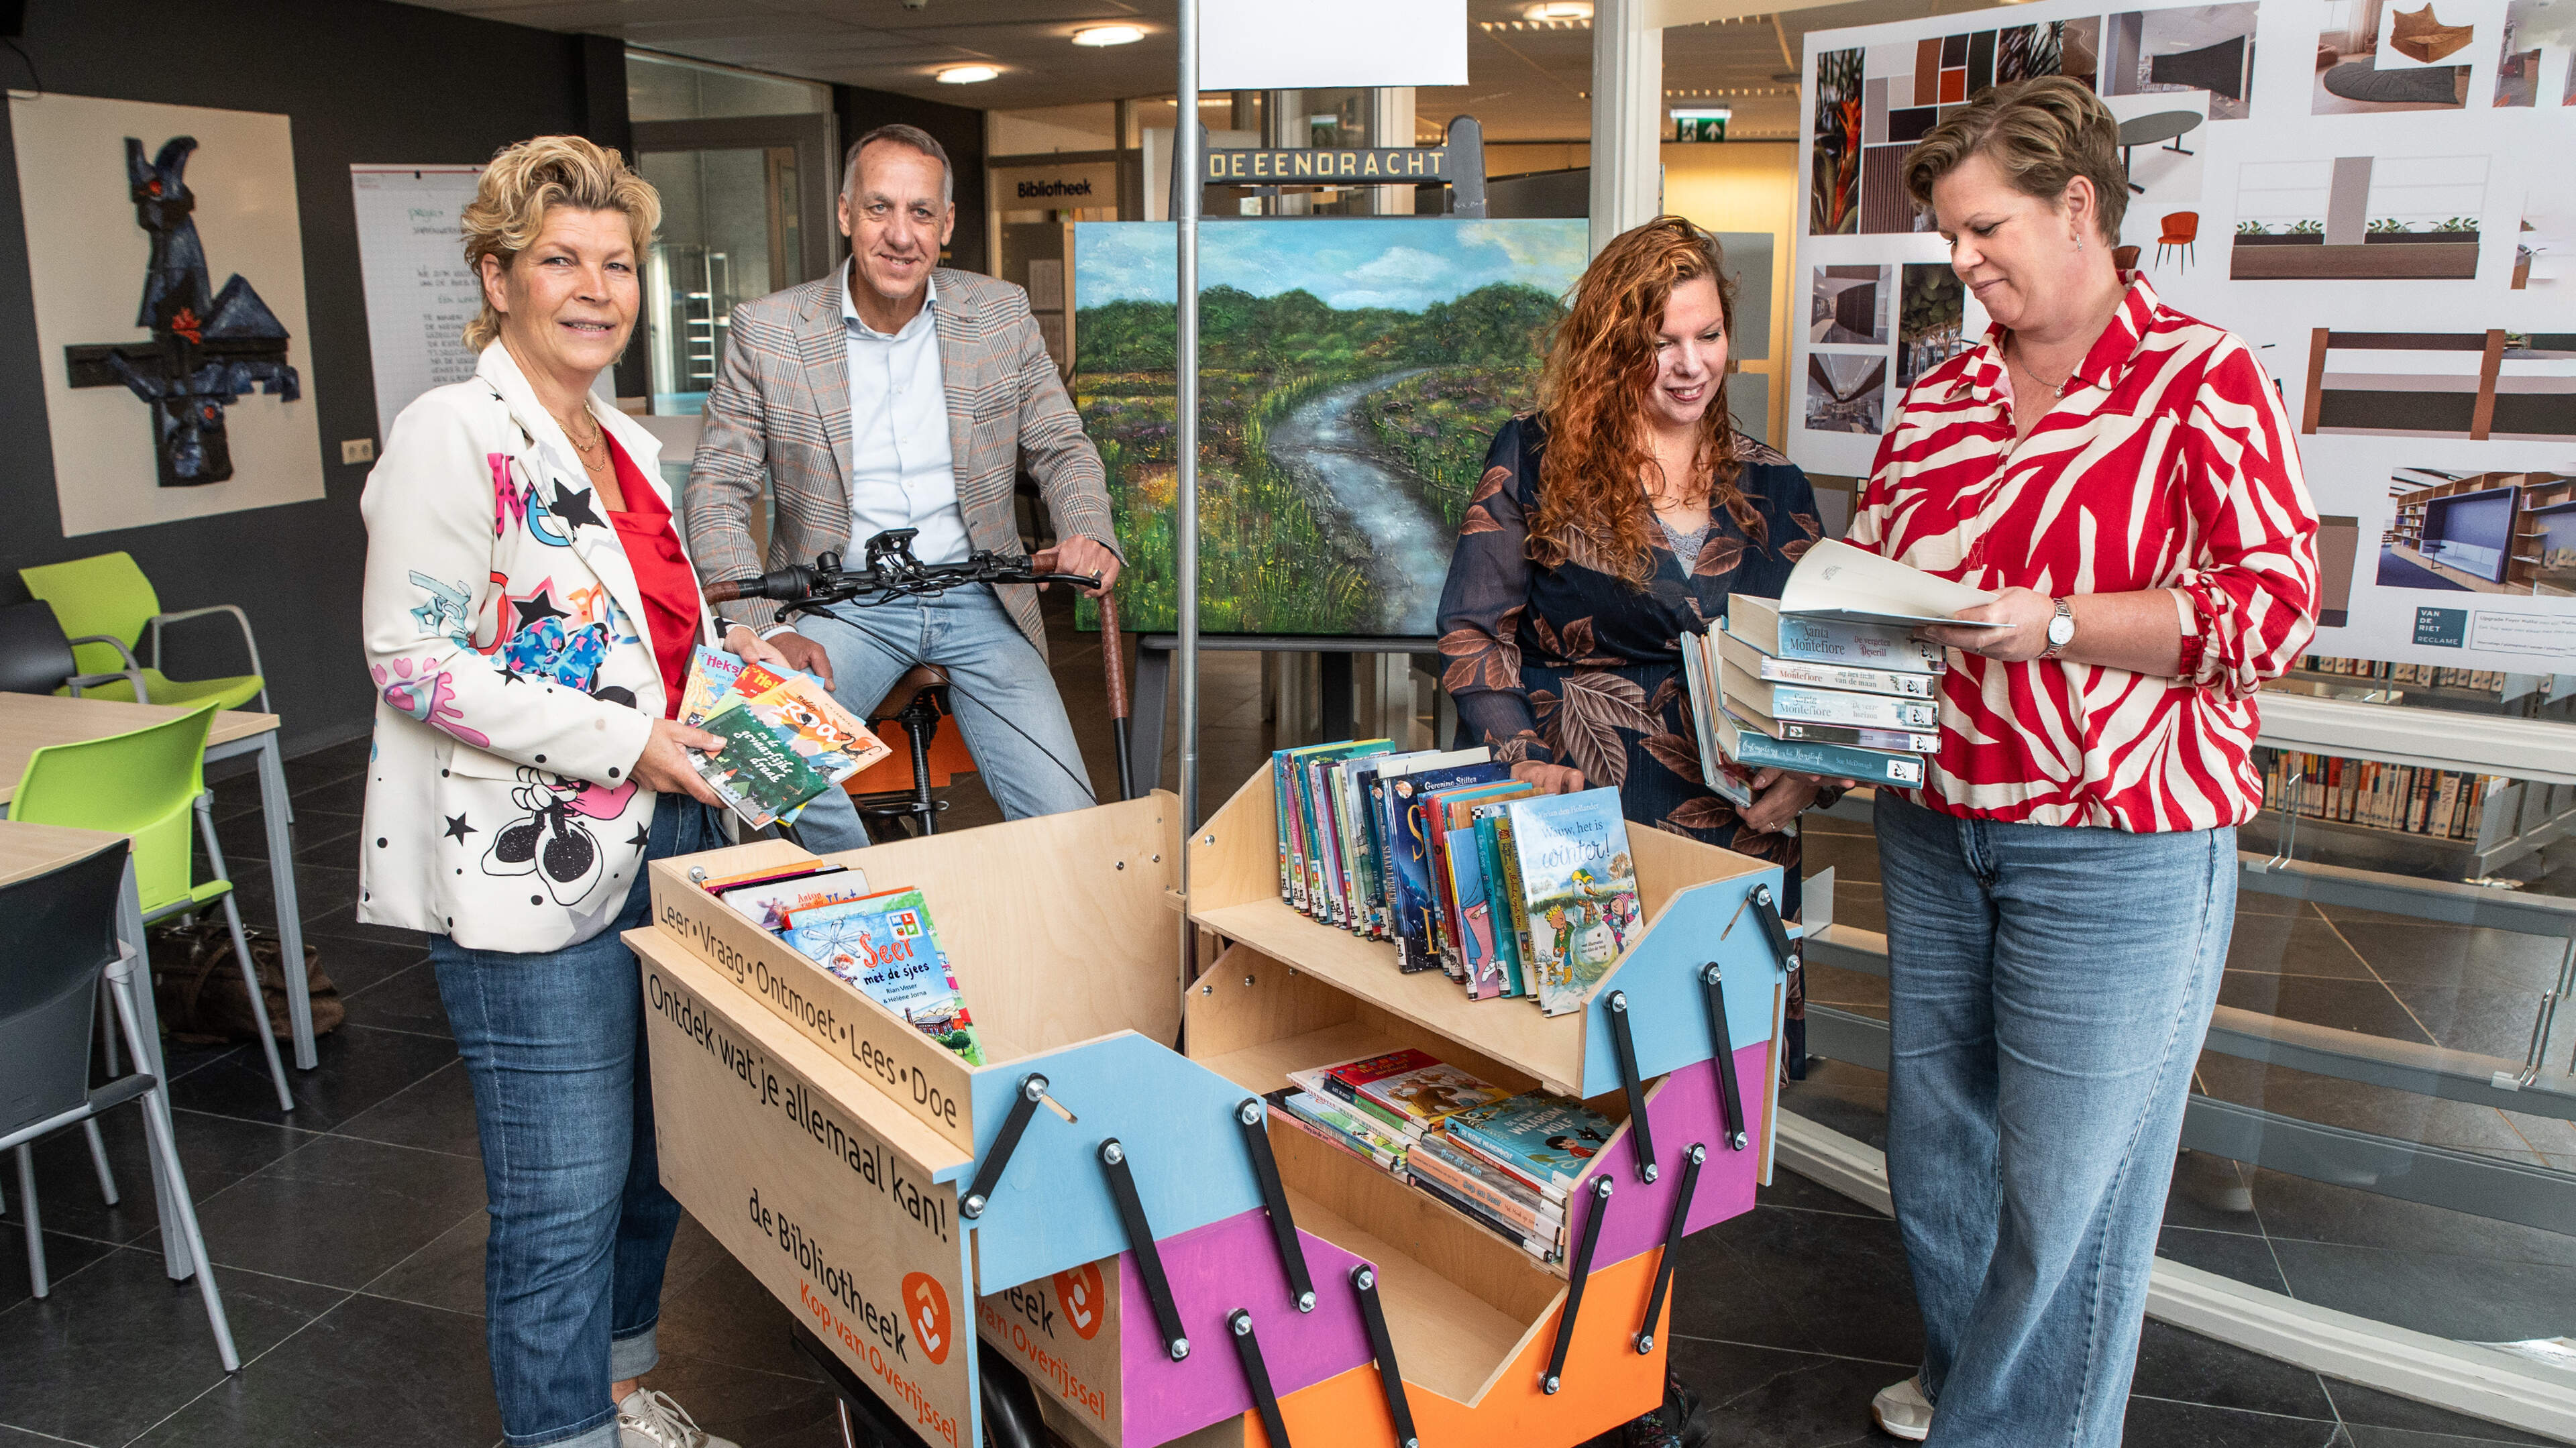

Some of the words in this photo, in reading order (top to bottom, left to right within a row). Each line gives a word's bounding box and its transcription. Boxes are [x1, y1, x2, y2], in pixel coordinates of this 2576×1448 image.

[1018, 178, 1092, 198] Bibliotheek
[2420, 609, 2441, 617] VAN
[1803, 624, 1829, 641] Santa
[2418, 624, 2442, 632] RIET
[1790, 638, 1845, 655] Montefiore
[1854, 635, 1863, 644] De
[1864, 637, 1891, 647] vergeten
[2417, 635, 2459, 645] RECLAME
[1860, 645, 1887, 658] Deverill
[706, 655, 745, 677] Heksj
[1779, 670, 1823, 682] Montefiore
[1848, 677, 1857, 685] de
[1858, 680, 1877, 688] maan
[1780, 703, 1831, 717] Montefiore
[1853, 710, 1878, 720] horizon
[757, 732, 769, 740] en
[733, 730, 794, 774] gevaarlijke
[749, 758, 786, 783] draak
[1424, 780, 1455, 791] Geronimo
[1456, 775, 1477, 787] Stilton
[1576, 821, 1593, 834] het
[1594, 819, 1603, 831] is
[1542, 832, 1611, 869] winter!
[798, 892, 822, 903] Anton
[864, 972, 885, 985] met
[888, 968, 900, 980] de
[903, 963, 930, 981] sjees
[885, 987, 900, 995] Rian
[900, 983, 918, 991] Visser
[910, 990, 927, 999] Jorna
[658, 893, 691, 940] Leer
[700, 920, 746, 985] Vraag
[755, 960, 838, 1044] Ontmoet
[851, 1023, 896, 1085] Lees
[912, 1066, 957, 1129] Doe
[649, 973, 716, 1056] Ontdek
[718, 1033, 757, 1090] wat
[759, 1057, 780, 1106] je
[786, 1083, 886, 1194] allemaal
[890, 1155, 949, 1244] kan!
[1508, 1107, 1568, 1135] WAAROM
[1536, 1117, 1575, 1135] WOLF
[749, 1186, 773, 1237] de
[778, 1211, 909, 1364] Bibliotheek
[800, 1278, 832, 1332] Kop
[834, 1316, 867, 1362] van
[869, 1345, 959, 1448] Overijssel
[1012, 1323, 1107, 1423] Overijssel
